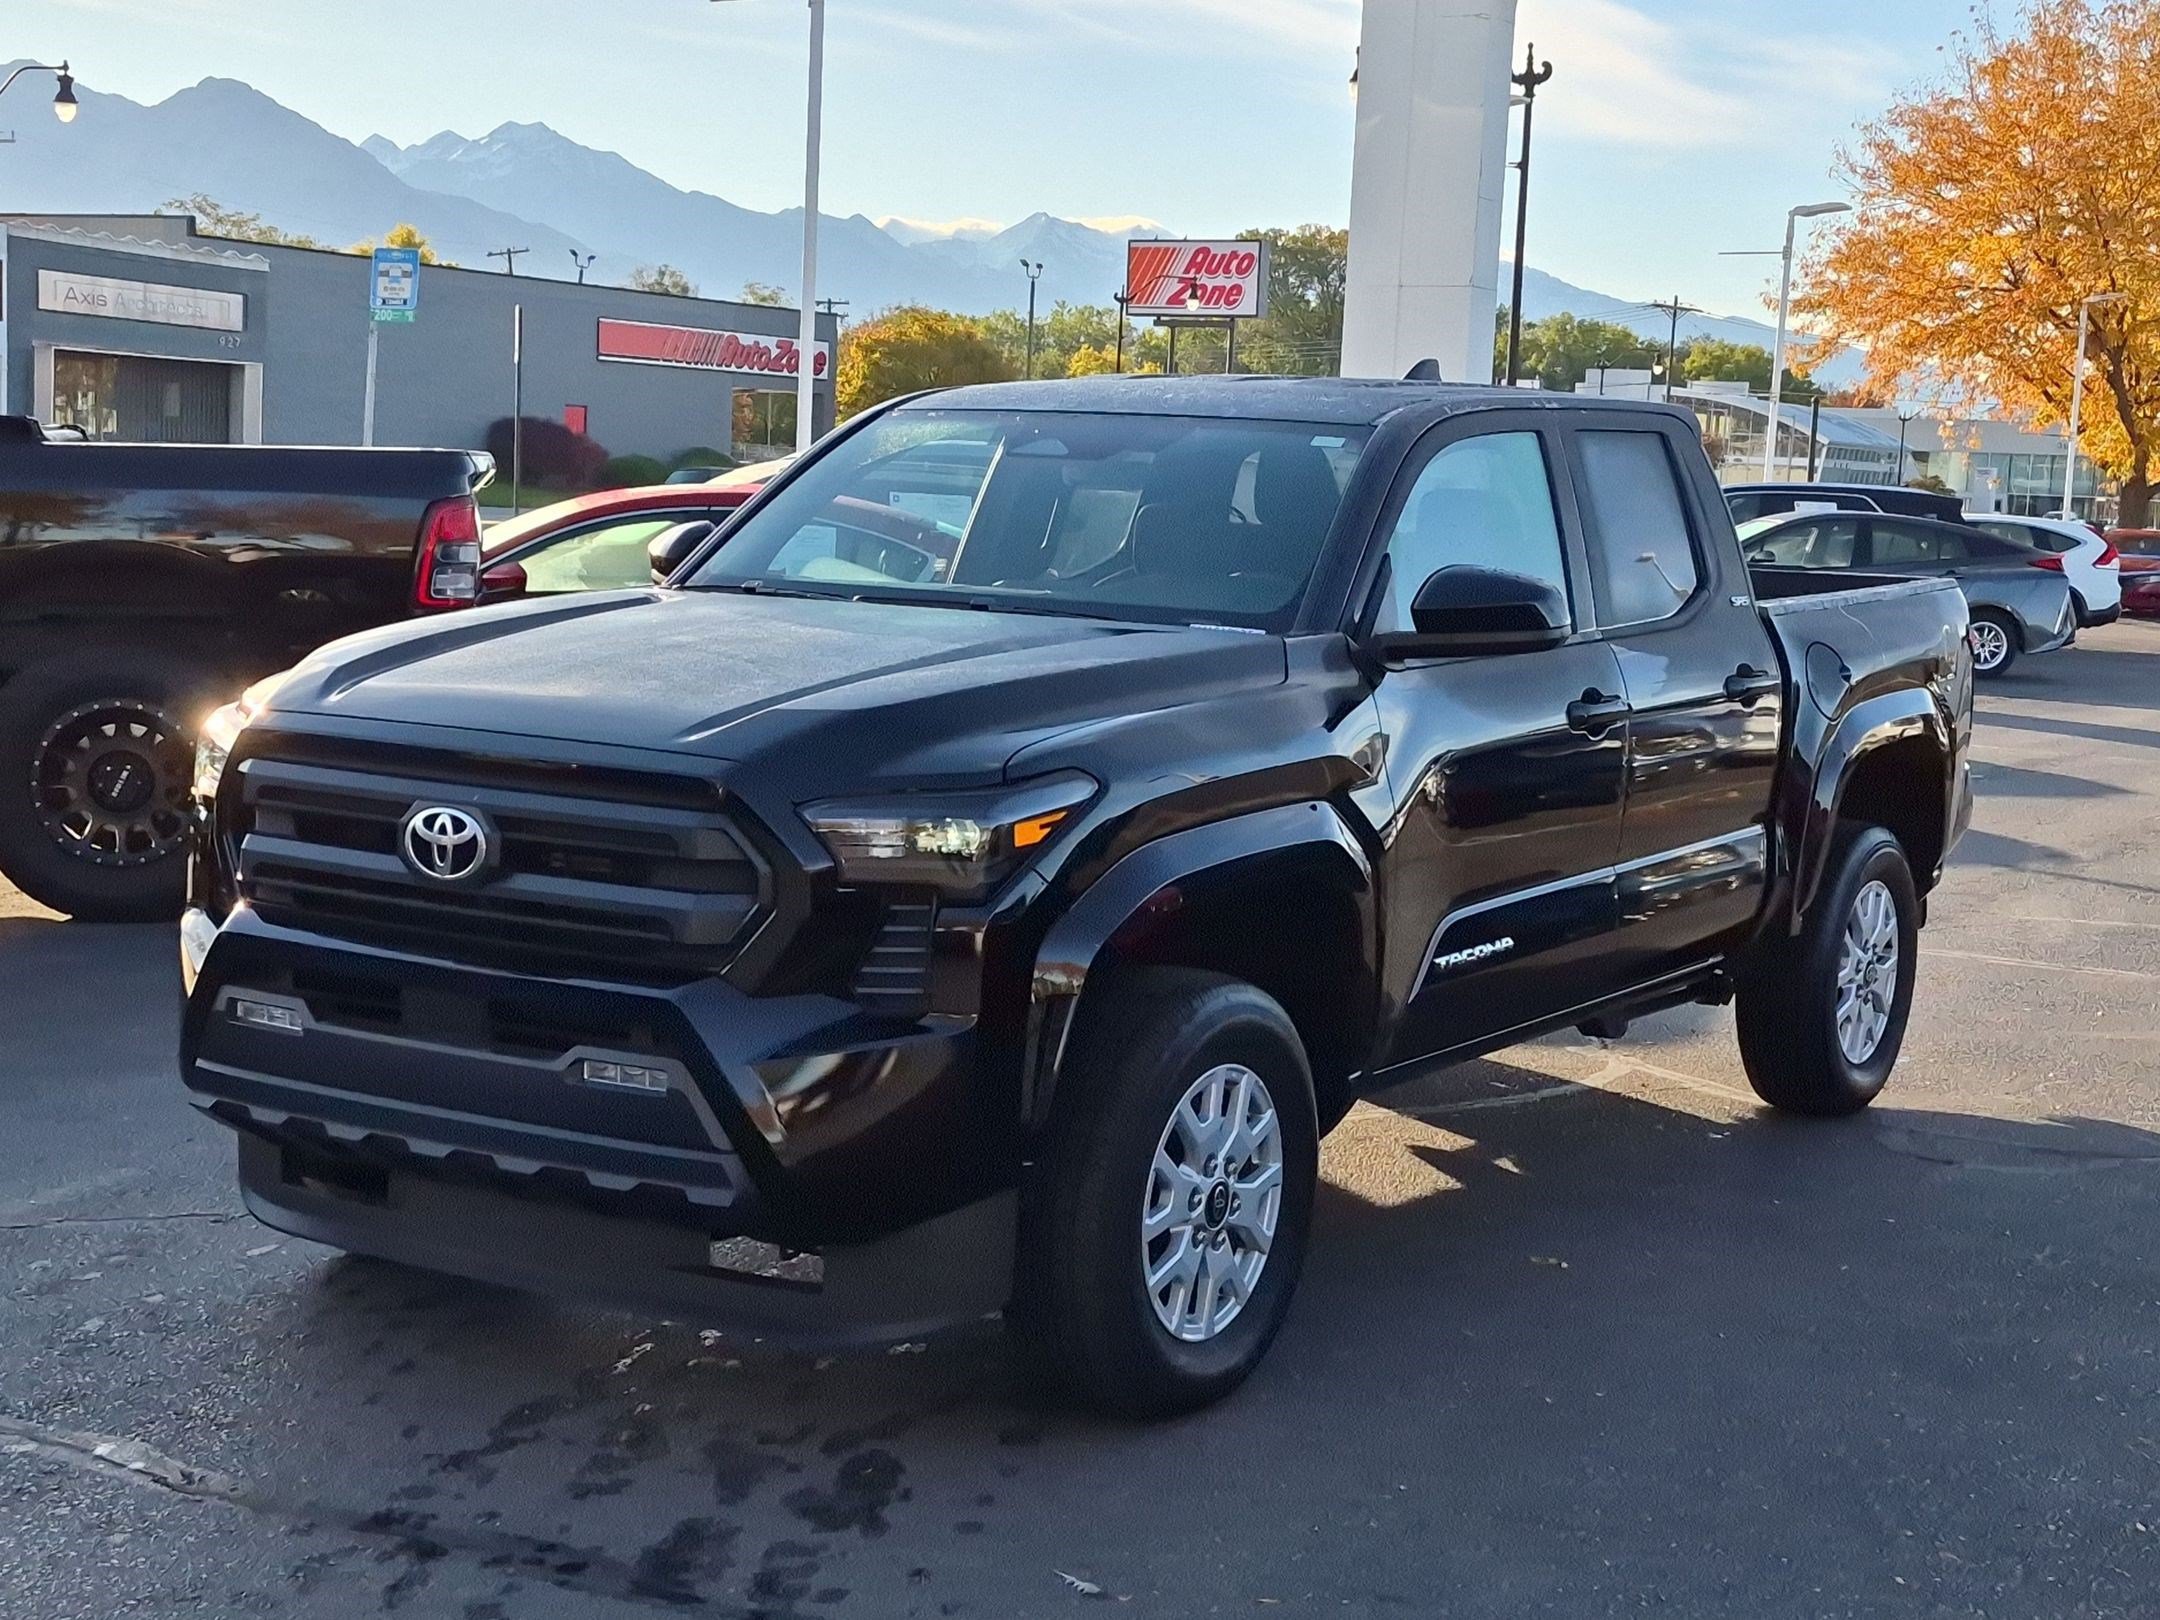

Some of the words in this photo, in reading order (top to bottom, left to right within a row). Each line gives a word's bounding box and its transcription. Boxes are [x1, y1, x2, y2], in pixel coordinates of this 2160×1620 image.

[1183, 246, 1256, 276] Auto
[64, 286, 108, 308] Axis
[218, 335, 242, 348] 927
[720, 334, 827, 377] AutoZoe
[1433, 936, 1515, 969] TACOMA
